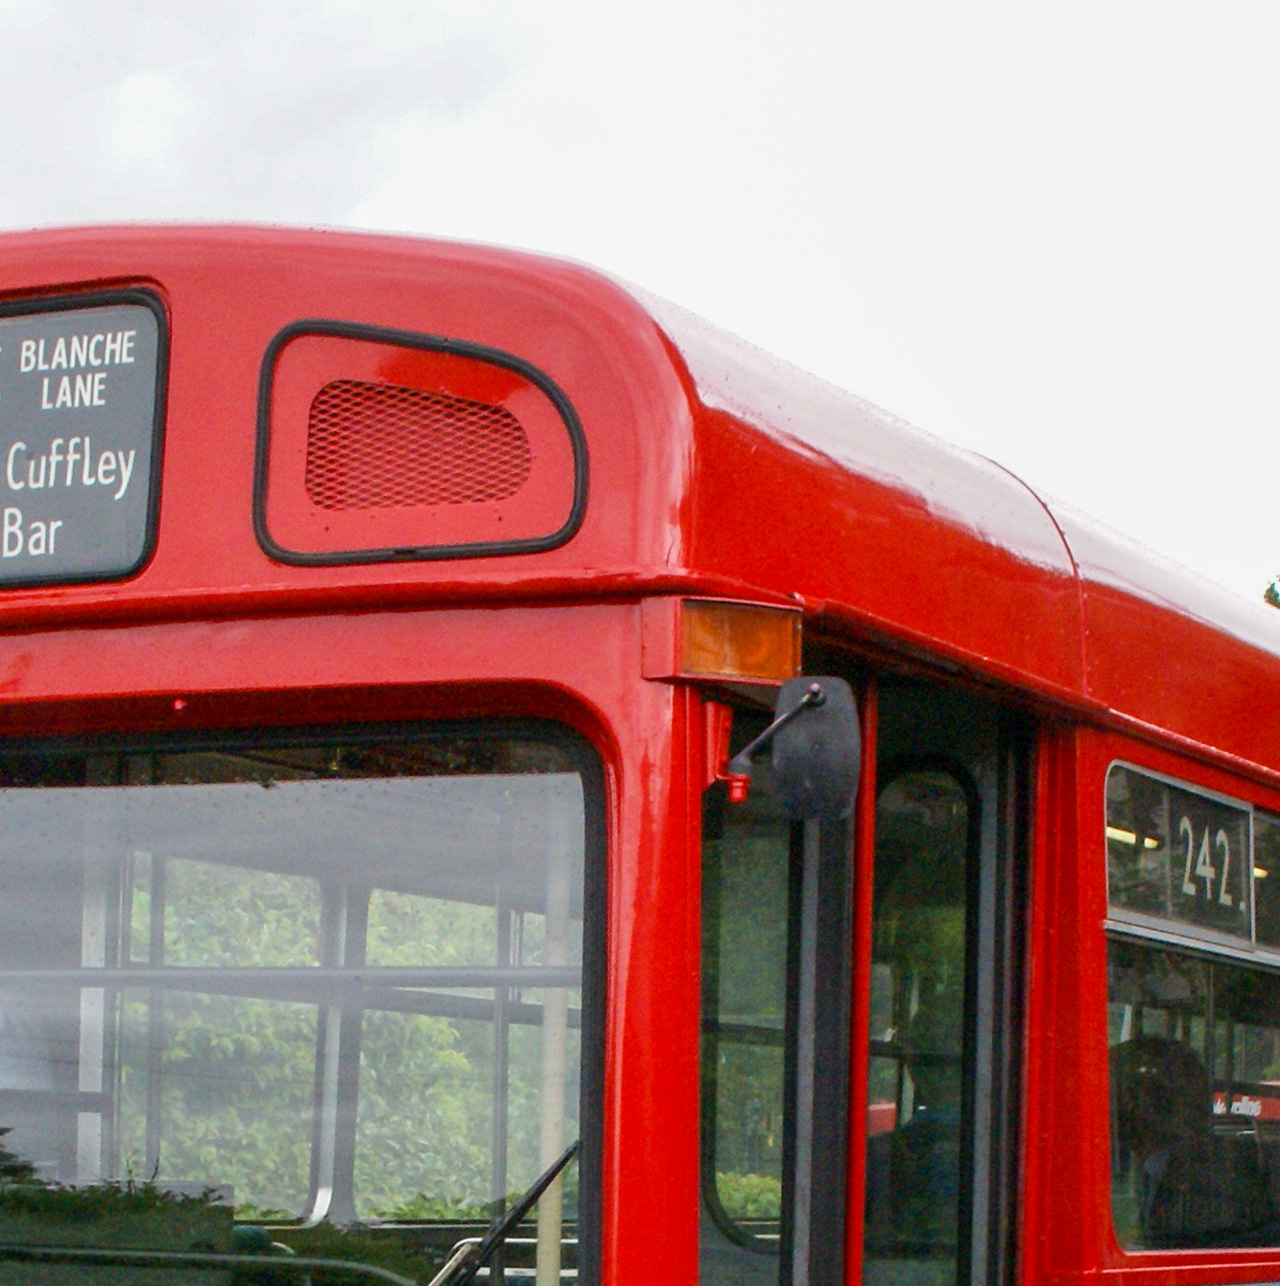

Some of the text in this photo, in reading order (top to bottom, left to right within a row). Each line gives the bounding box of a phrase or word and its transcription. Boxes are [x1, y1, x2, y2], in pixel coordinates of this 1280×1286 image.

[20, 330, 137, 373] BLANCHE
[41, 371, 107, 411] LANE
[6, 437, 137, 502] Cuffley
[1, 507, 63, 559] Bar
[1179, 815, 1233, 907] 242
